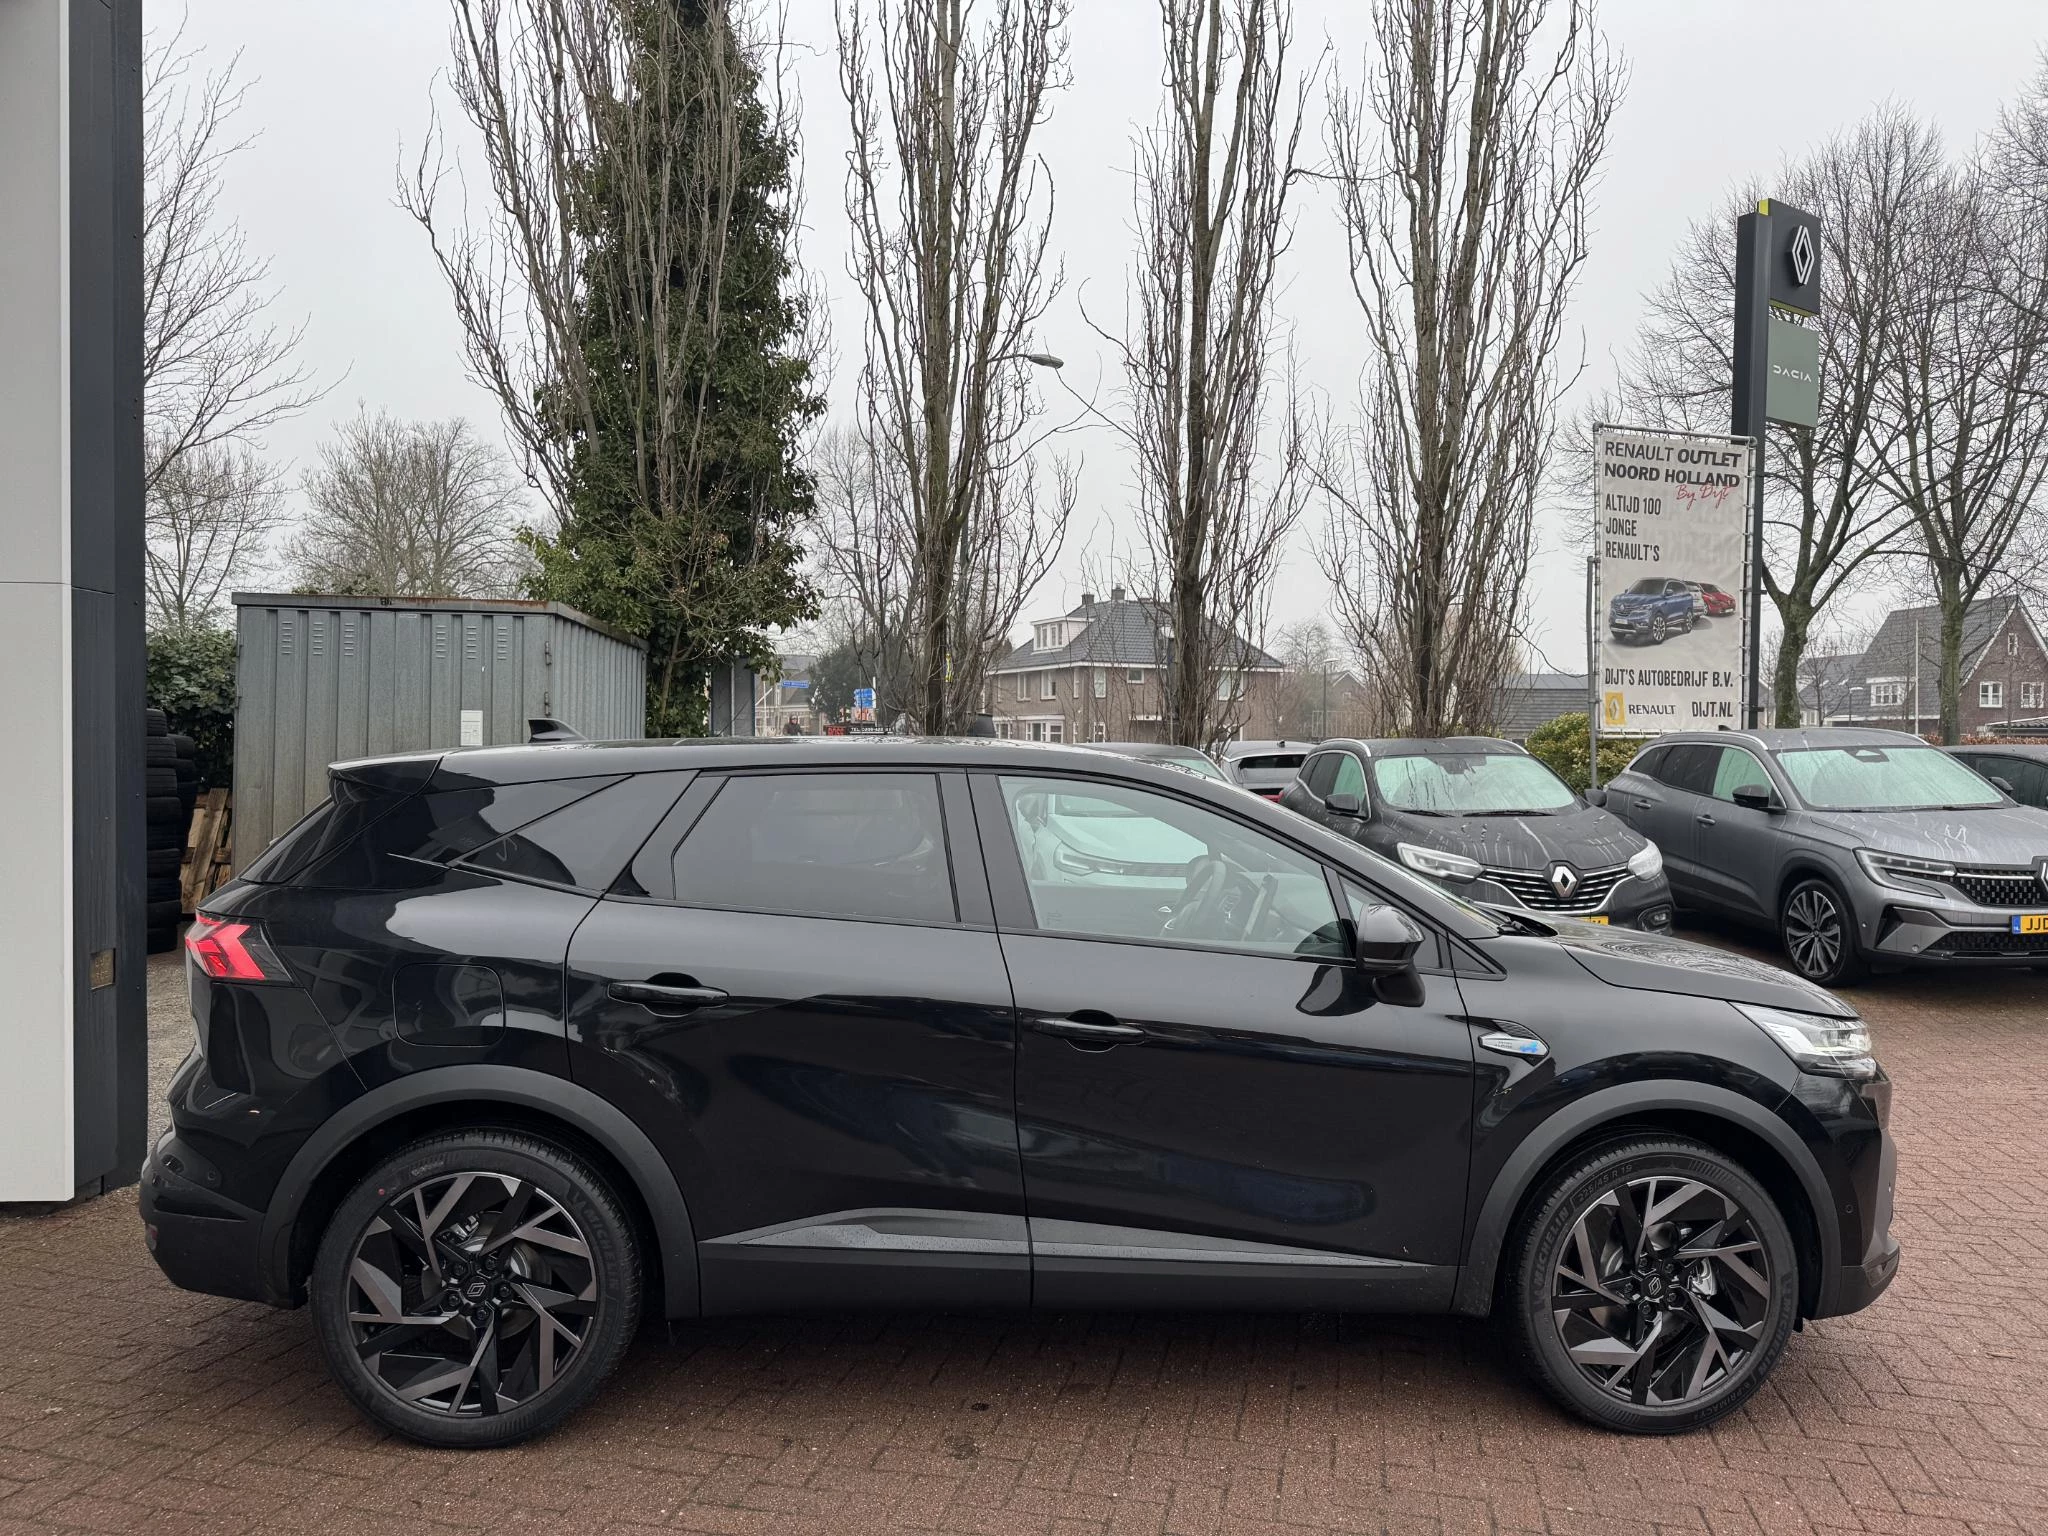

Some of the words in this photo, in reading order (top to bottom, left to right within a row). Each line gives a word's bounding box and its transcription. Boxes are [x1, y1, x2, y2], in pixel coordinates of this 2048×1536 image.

[1773, 364, 1812, 383] DACIA
[1605, 441, 1674, 462] RENAULT
[1678, 448, 1742, 468] OUTLET
[1604, 462, 1660, 481] NOORD
[1664, 469, 1740, 488] HOLLAND
[1605, 493, 1640, 514] ALTIJD
[1643, 497, 1661, 515] 100
[1675, 484, 1696, 511] By
[1605, 517, 1637, 536] JONGE
[1605, 540, 1660, 562] RENAULT'S
[1605, 668, 1635, 686] DIJT'S
[1638, 669, 1709, 687] AUTOBEDRIJF
[1712, 671, 1734, 687] B.V.
[1628, 704, 1676, 715] RENAULT
[1691, 701, 1733, 718] DIJT.NL
[1533, 1206, 1571, 1287] MICHELIN
